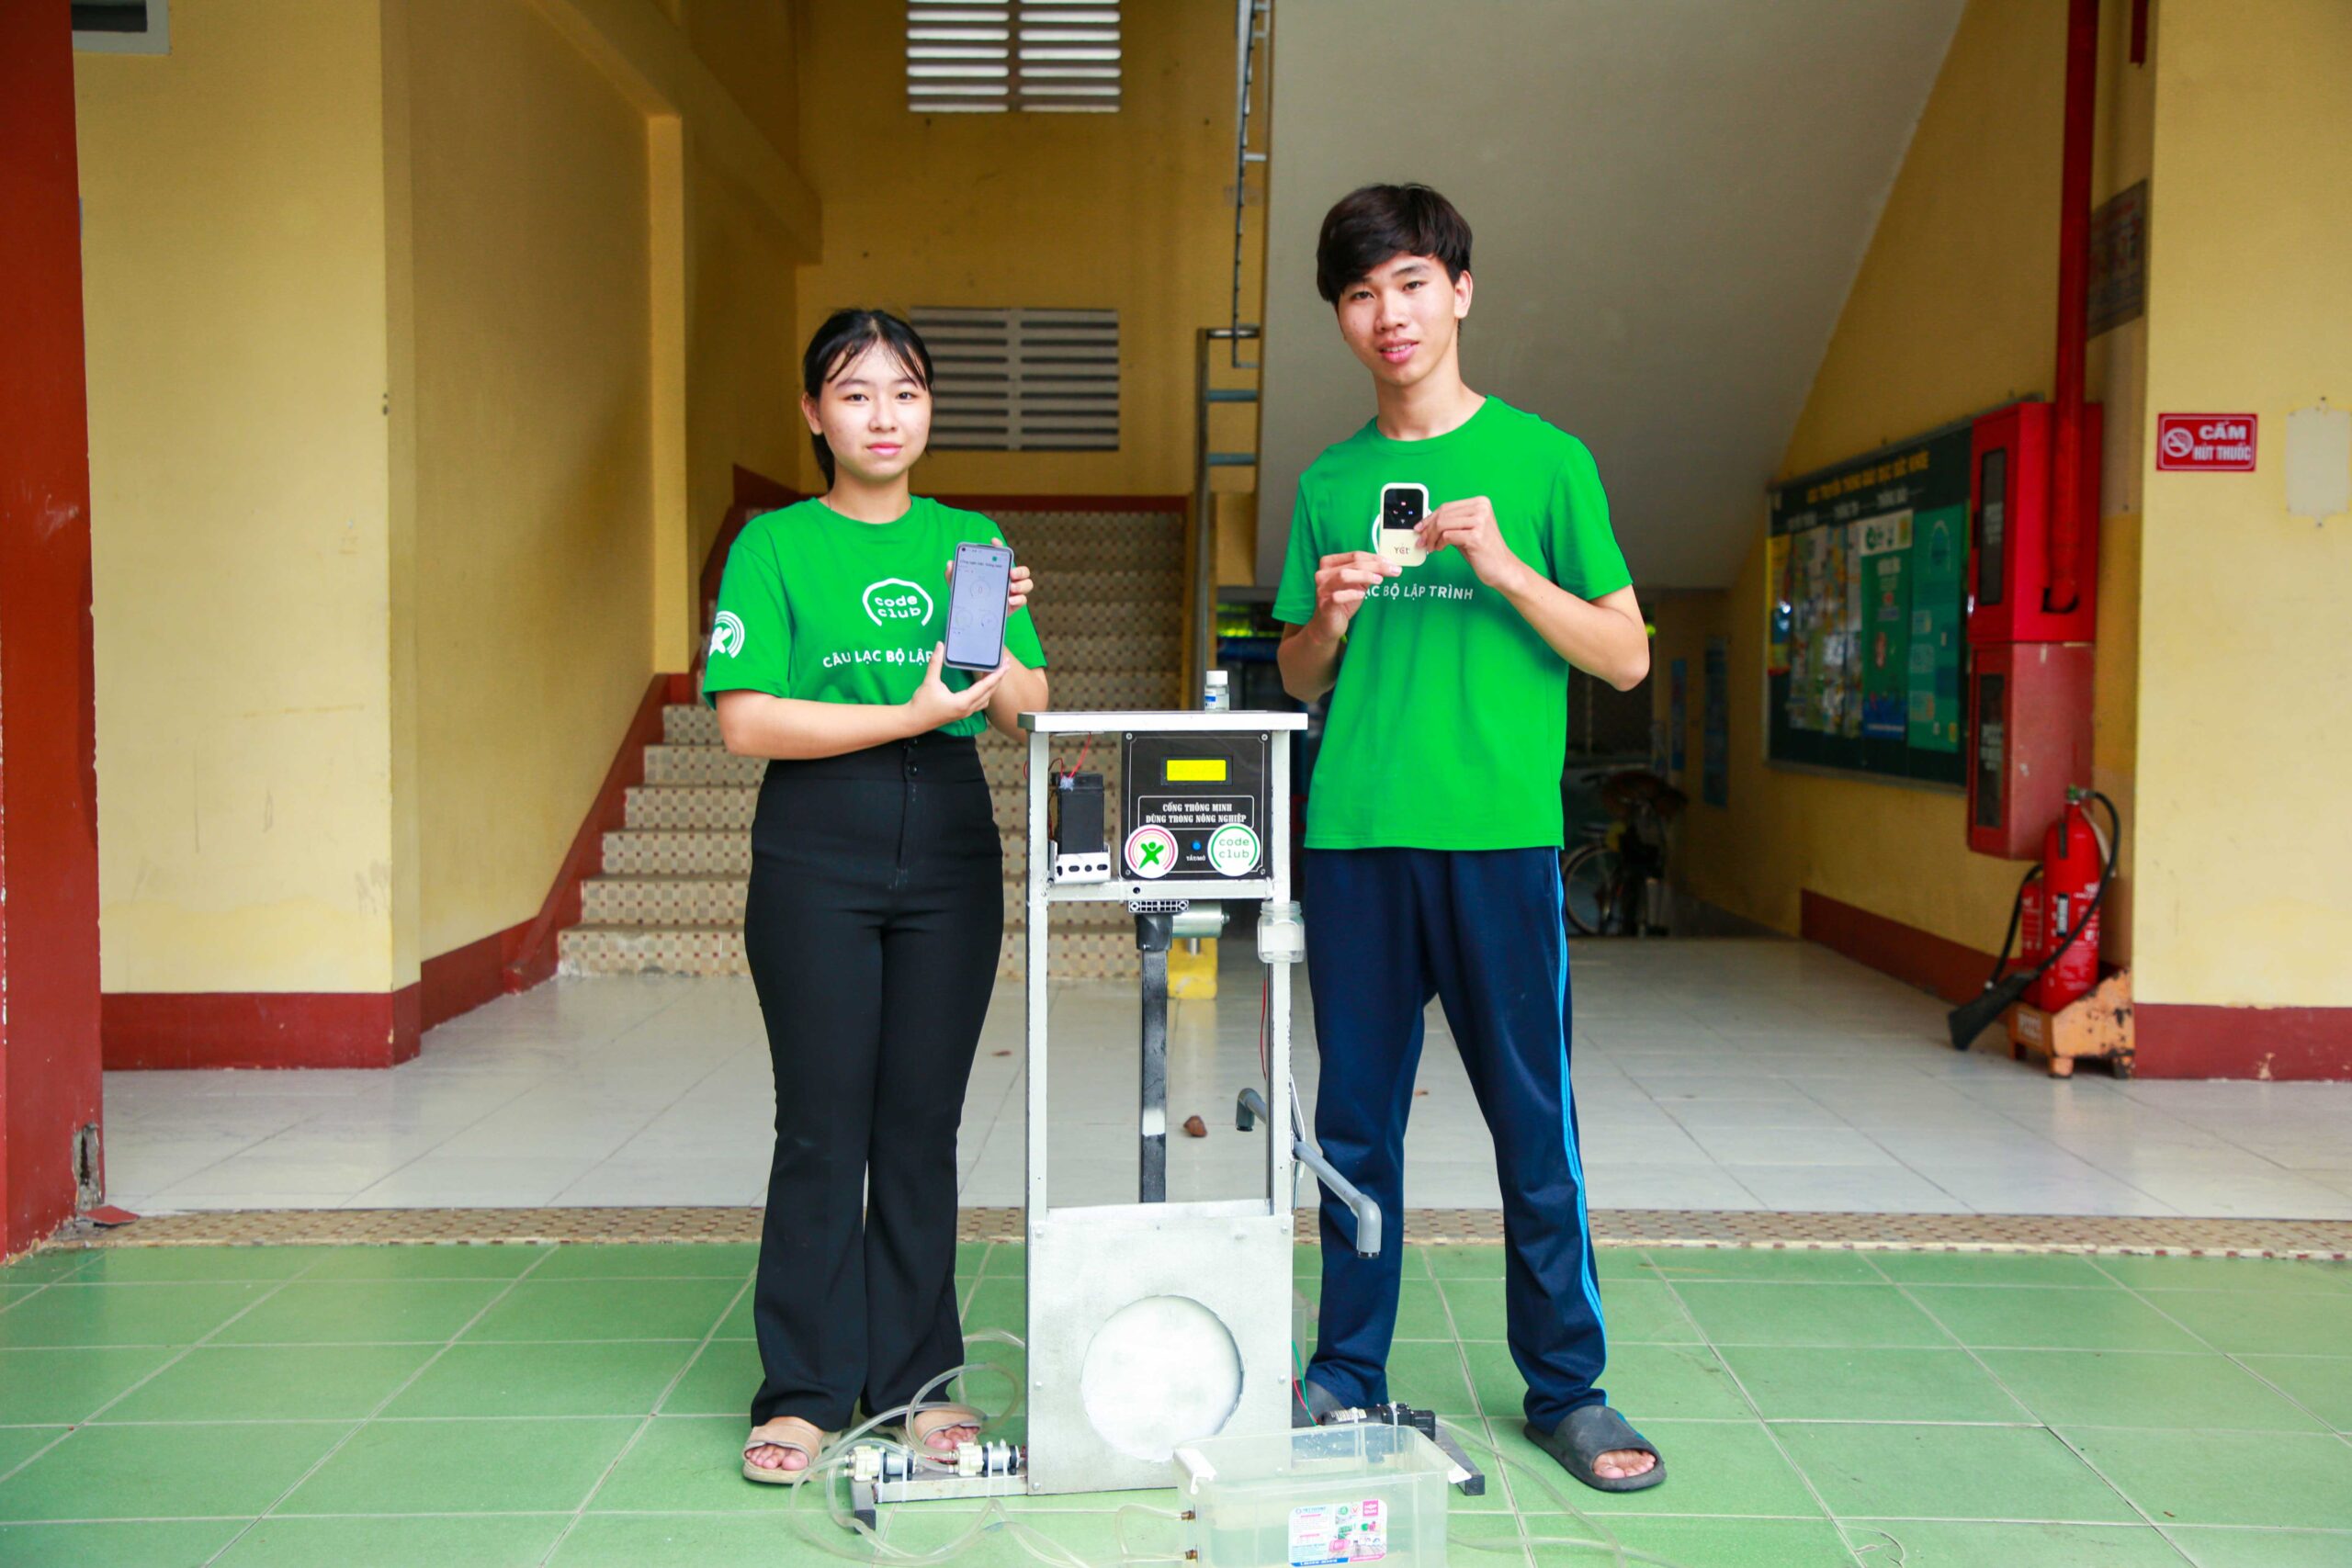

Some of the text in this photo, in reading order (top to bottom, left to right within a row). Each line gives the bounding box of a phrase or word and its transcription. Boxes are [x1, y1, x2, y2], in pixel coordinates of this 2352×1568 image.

[2199, 421, 2246, 440] CẤM
[2193, 442, 2251, 460] HÚT THUỐC
[1364, 582, 1474, 601] ẠC BỘ LẬP TRÌNH
[875, 595, 918, 607] code
[877, 607, 922, 618] club
[823, 651, 852, 668] CÂU
[854, 650, 882, 665] LẠC
[886, 648, 905, 666] BỘ
[1184, 802, 1210, 812] THÔNG
[1212, 804, 1232, 812] MINH
[1169, 815, 1193, 823] TRONG
[1195, 813, 1216, 823] NÔNG
[1218, 813, 1247, 824] NGHIỆP
[1219, 838, 1250, 846] code
[1219, 849, 1250, 858] club
